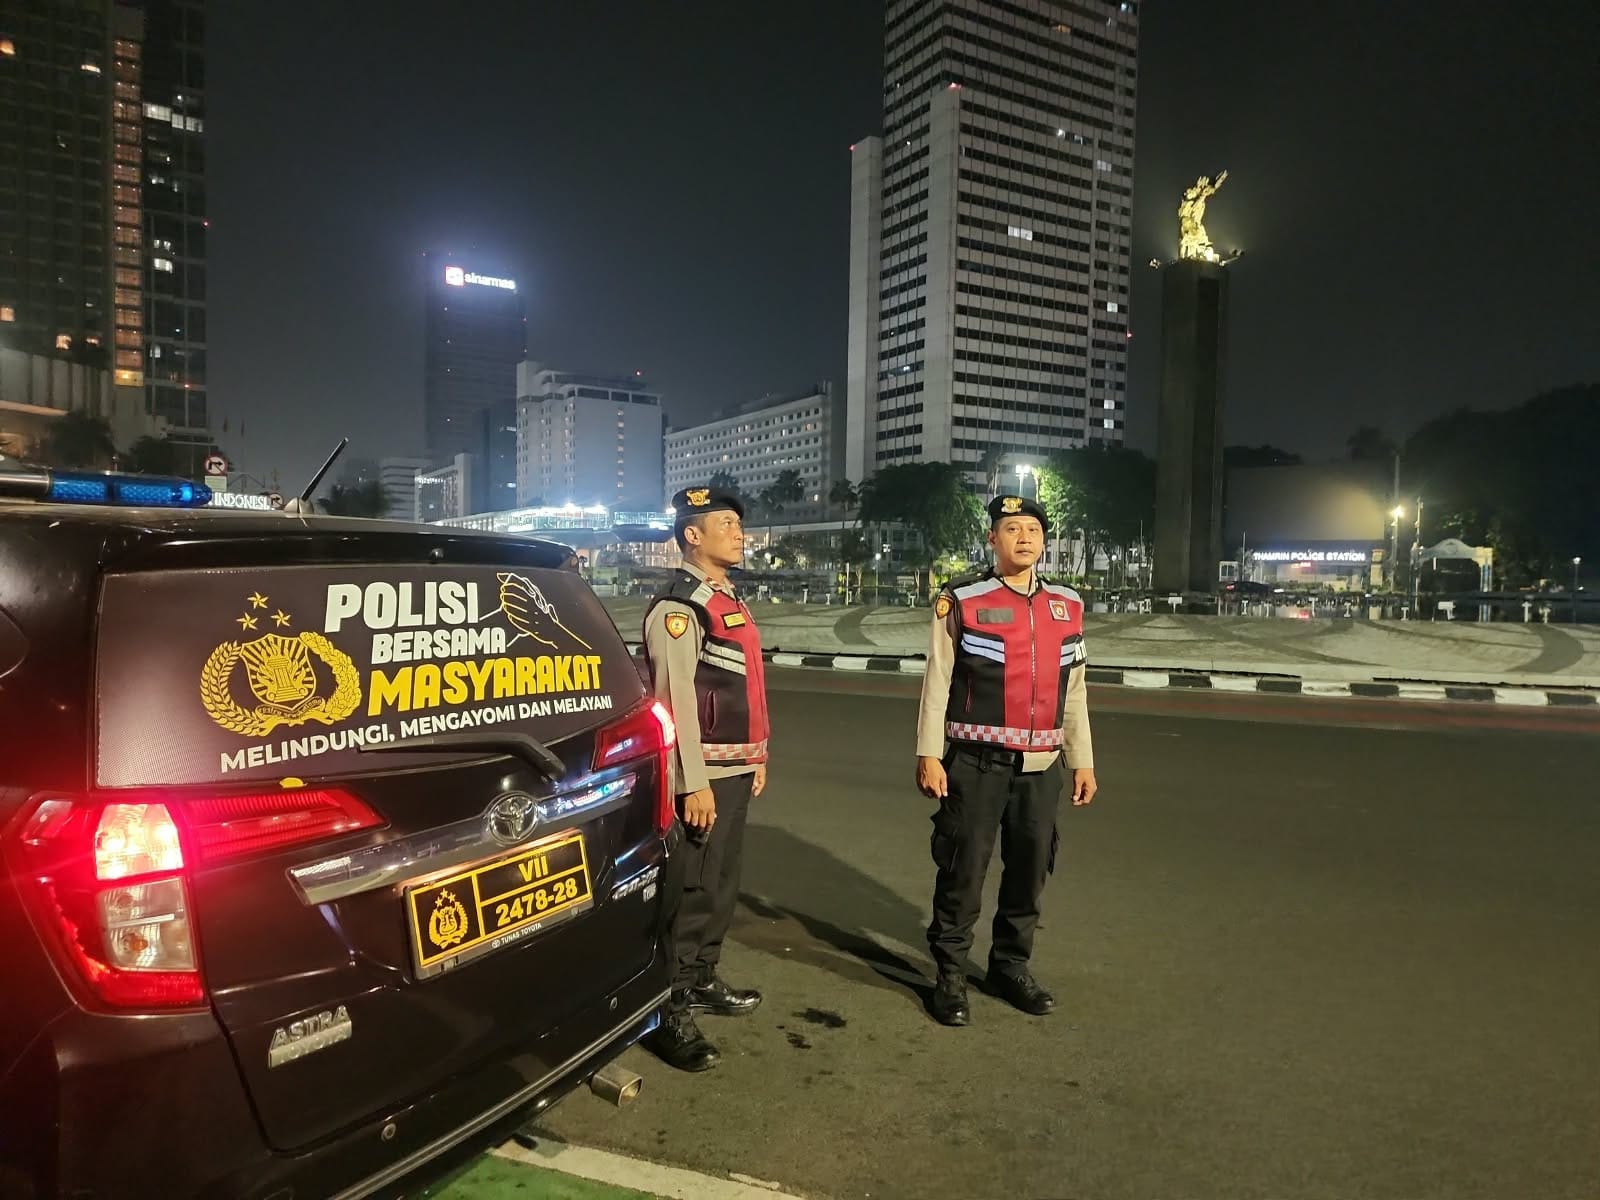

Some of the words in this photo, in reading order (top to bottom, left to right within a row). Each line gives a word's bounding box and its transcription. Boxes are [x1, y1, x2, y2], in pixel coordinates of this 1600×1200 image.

[464, 272, 516, 289] sinarmas
[214, 492, 275, 511] INDONESI
[1253, 551, 1289, 561] THAMRIN
[1291, 551, 1324, 561] POLICE
[1326, 551, 1366, 561] STATION
[324, 581, 479, 633] POLISI
[371, 627, 506, 664] BERSAMA
[367, 655, 602, 717] MASYARAKAT
[220, 723, 395, 774] MELINDUNGI,
[400, 706, 516, 737] MENGAYOMI
[521, 700, 552, 720] DAN
[554, 695, 613, 714] MELAYANI
[518, 855, 549, 882] VII
[495, 877, 578, 927] 2478-28
[501, 931, 520, 944] TUNAS
[521, 922, 542, 936] TOYOTA
[271, 1005, 351, 1049] ASTRA
